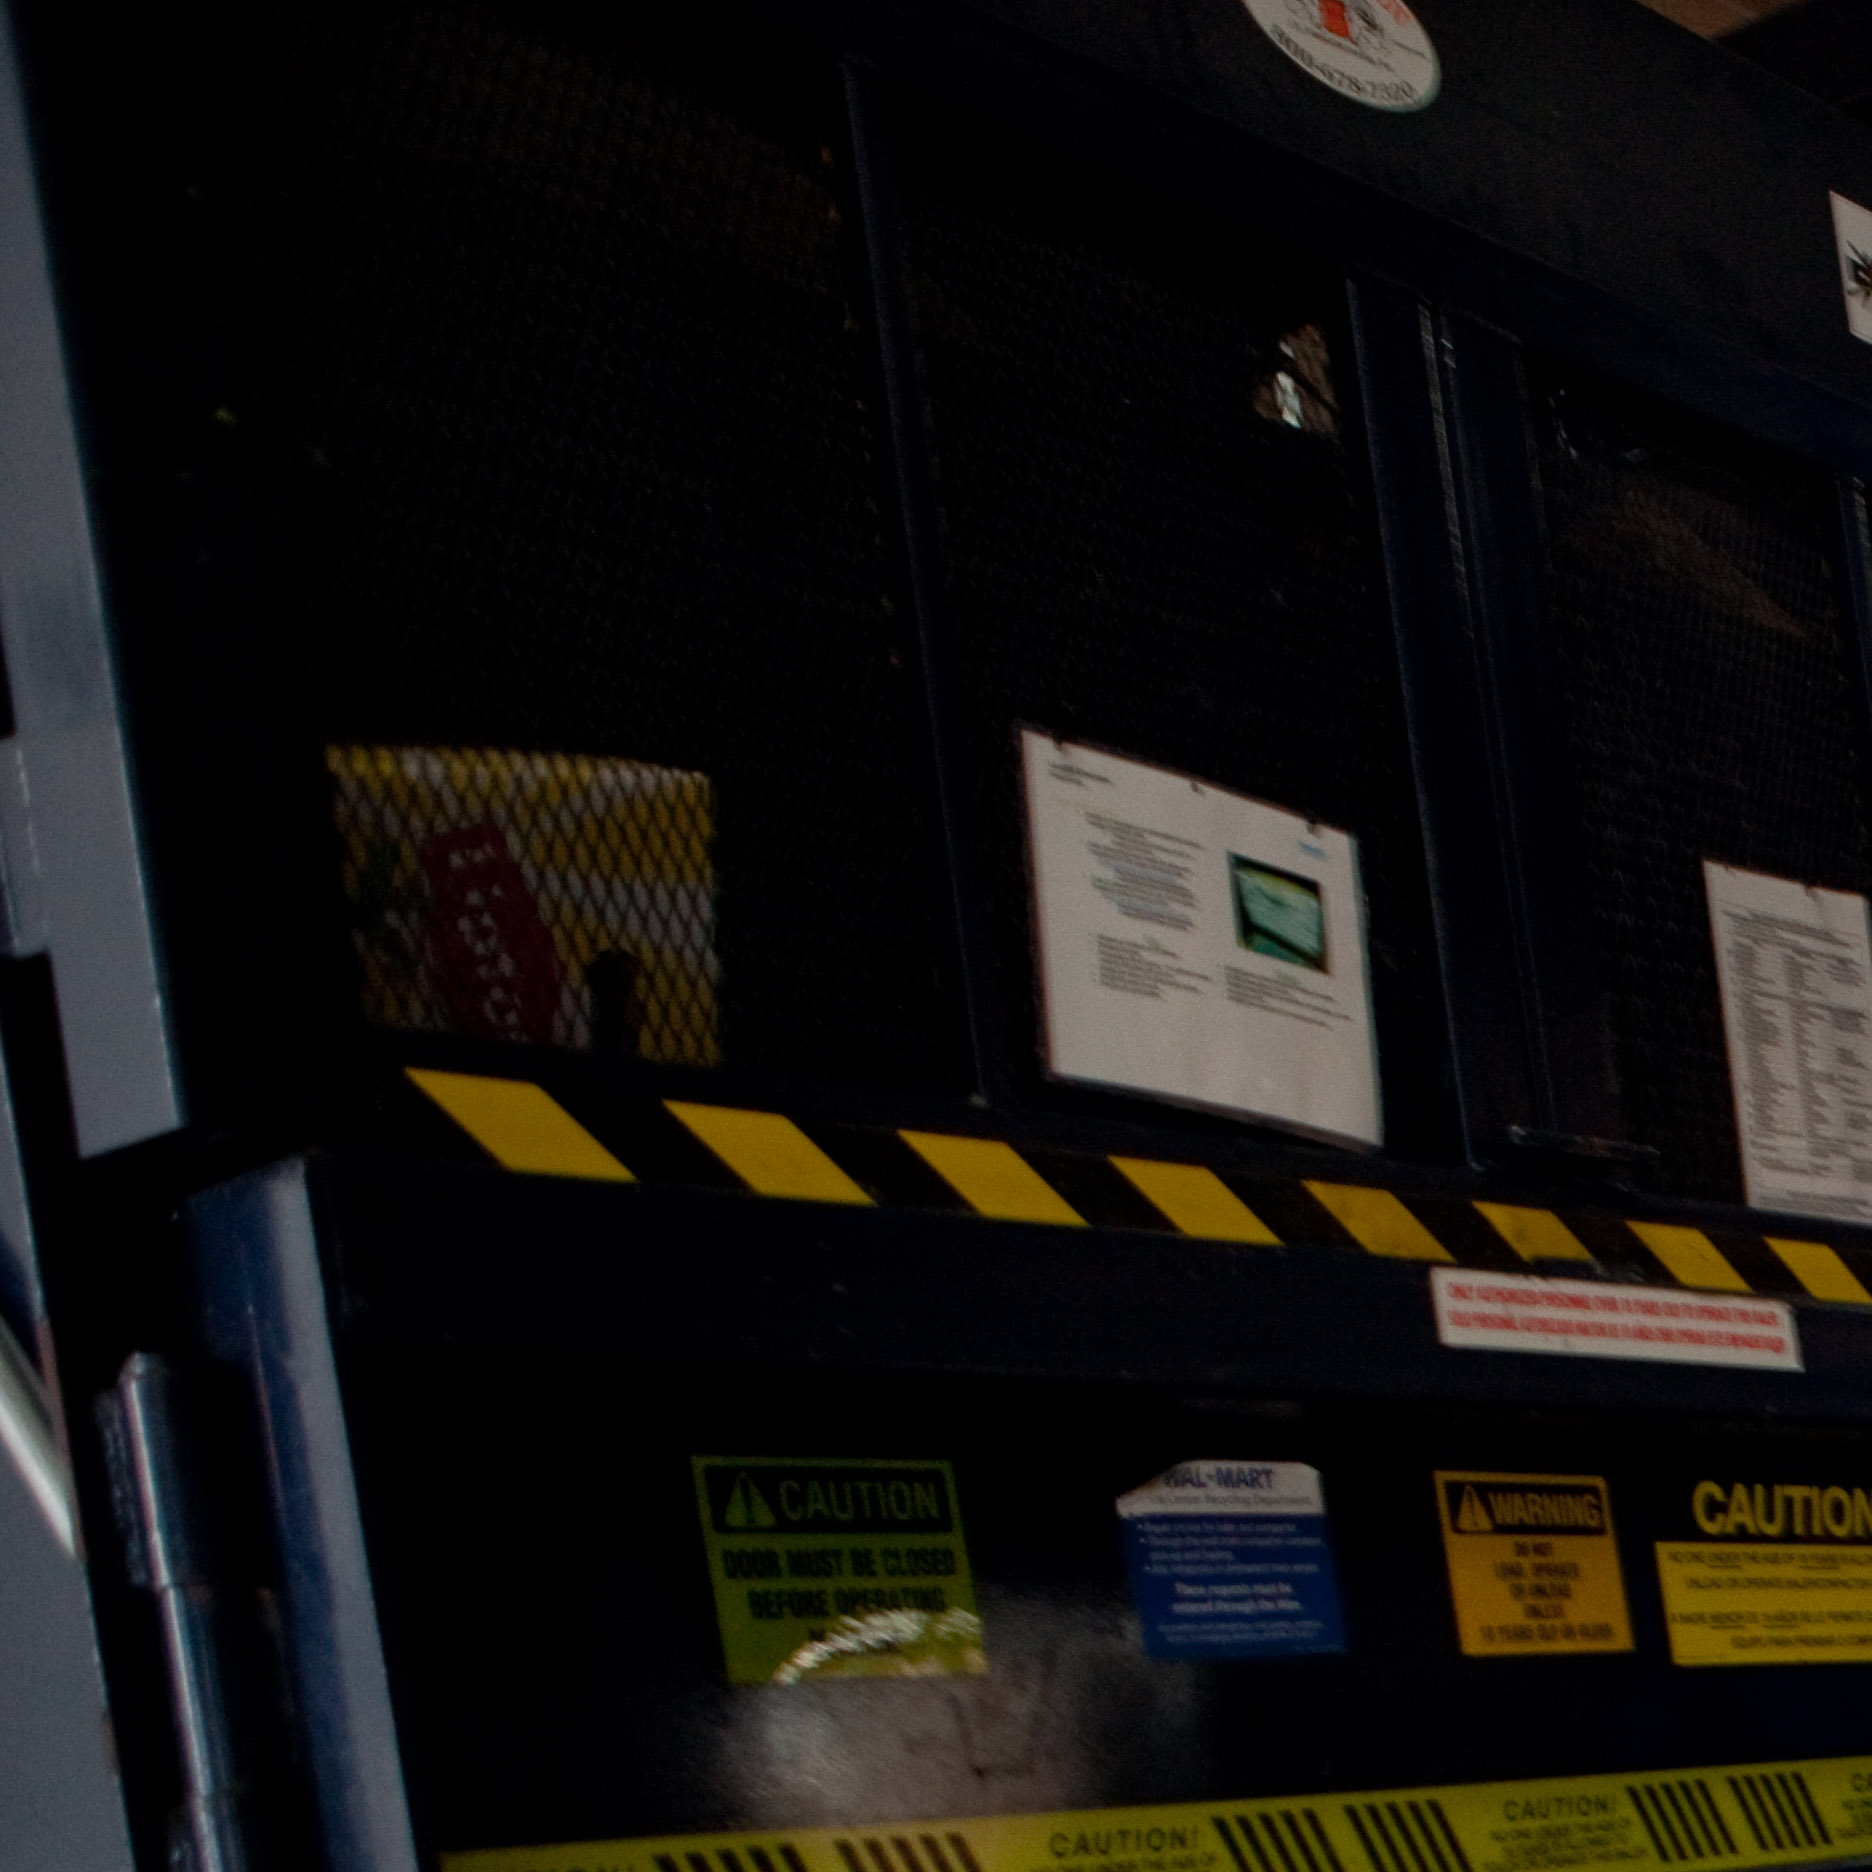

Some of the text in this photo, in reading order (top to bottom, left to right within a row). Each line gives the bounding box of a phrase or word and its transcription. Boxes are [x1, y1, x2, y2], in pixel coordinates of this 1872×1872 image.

[778, 1478, 942, 1522] CAUTION
[1486, 1489, 1602, 1529] WARNING
[722, 1547, 957, 1580] DOOR MUST BE CLOSED
[1513, 1541, 1555, 1557] DO NOT
[1531, 1561, 1580, 1580] OPERATE
[747, 1588, 831, 1619] BEFORE
[1502, 1792, 1618, 1822] CAUTION!
[1048, 1823, 1199, 1860] CAUTION!
